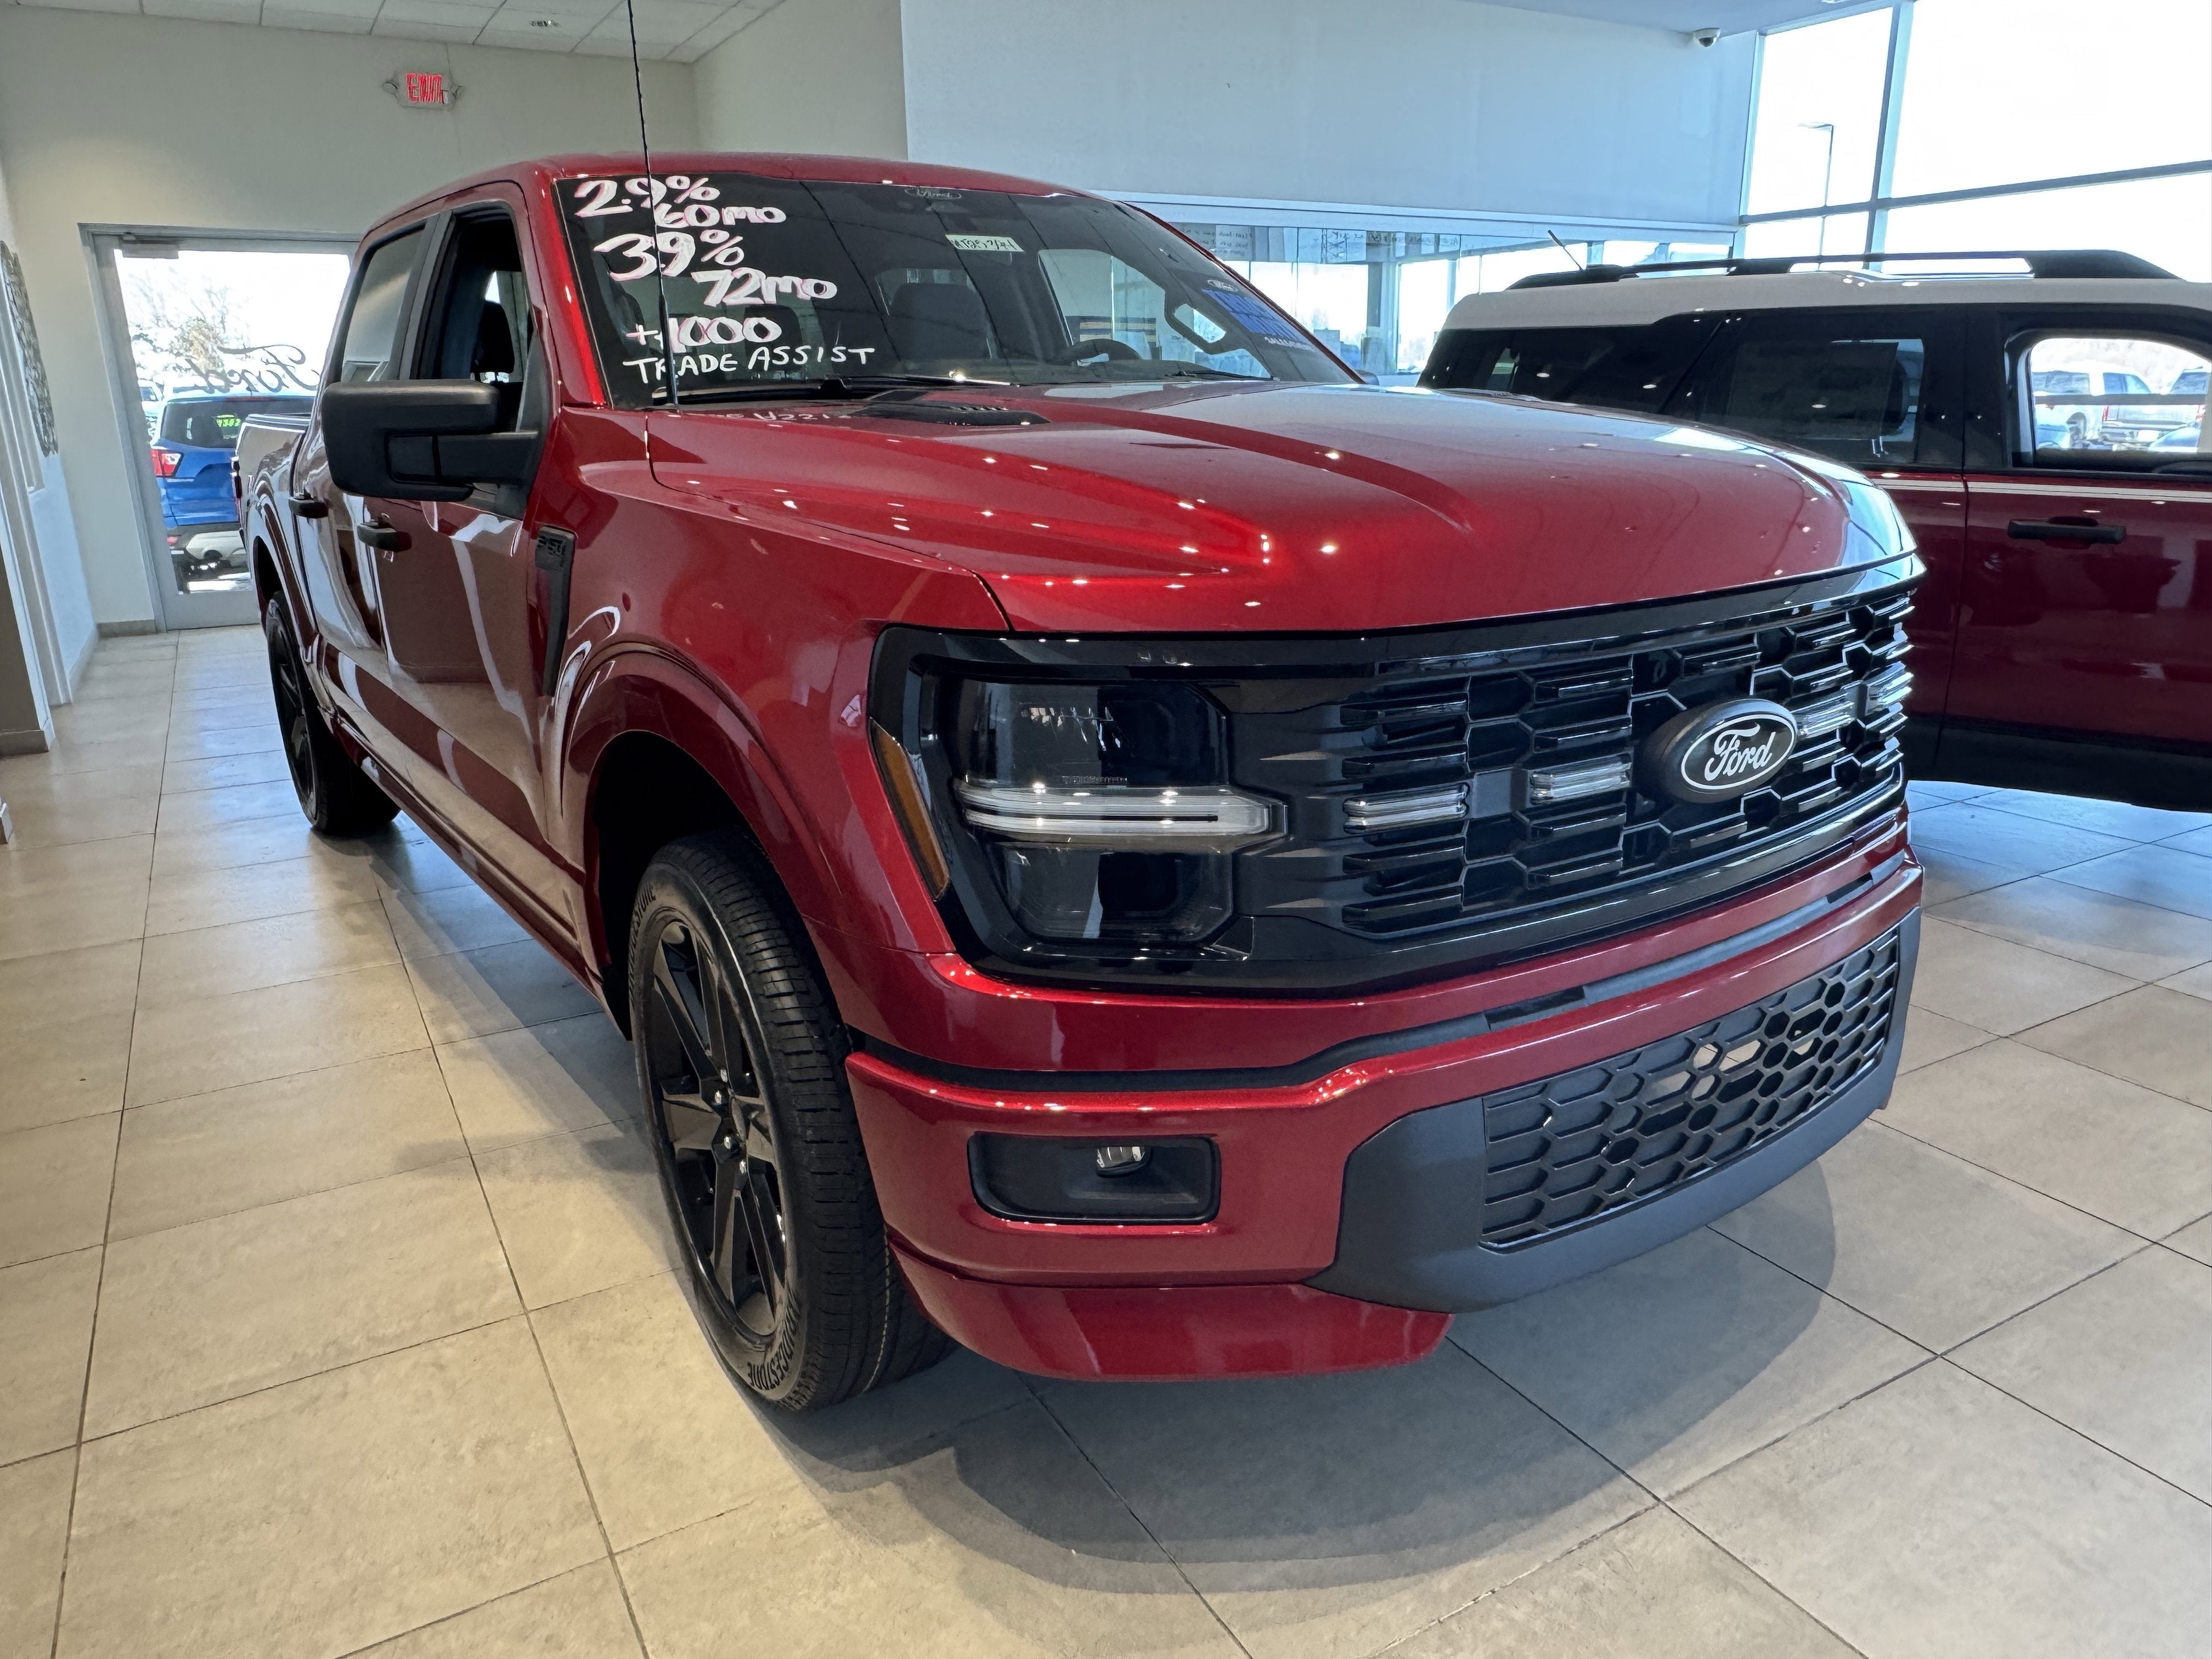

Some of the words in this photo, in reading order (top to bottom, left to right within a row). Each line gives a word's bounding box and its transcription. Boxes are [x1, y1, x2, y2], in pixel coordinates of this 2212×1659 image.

[574, 176, 720, 218] 2.9%
[654, 203, 787, 228] 60mo
[691, 267, 838, 307] 72mo
[748, 346, 875, 371] ASSIST
[1704, 721, 1777, 782] Ford
